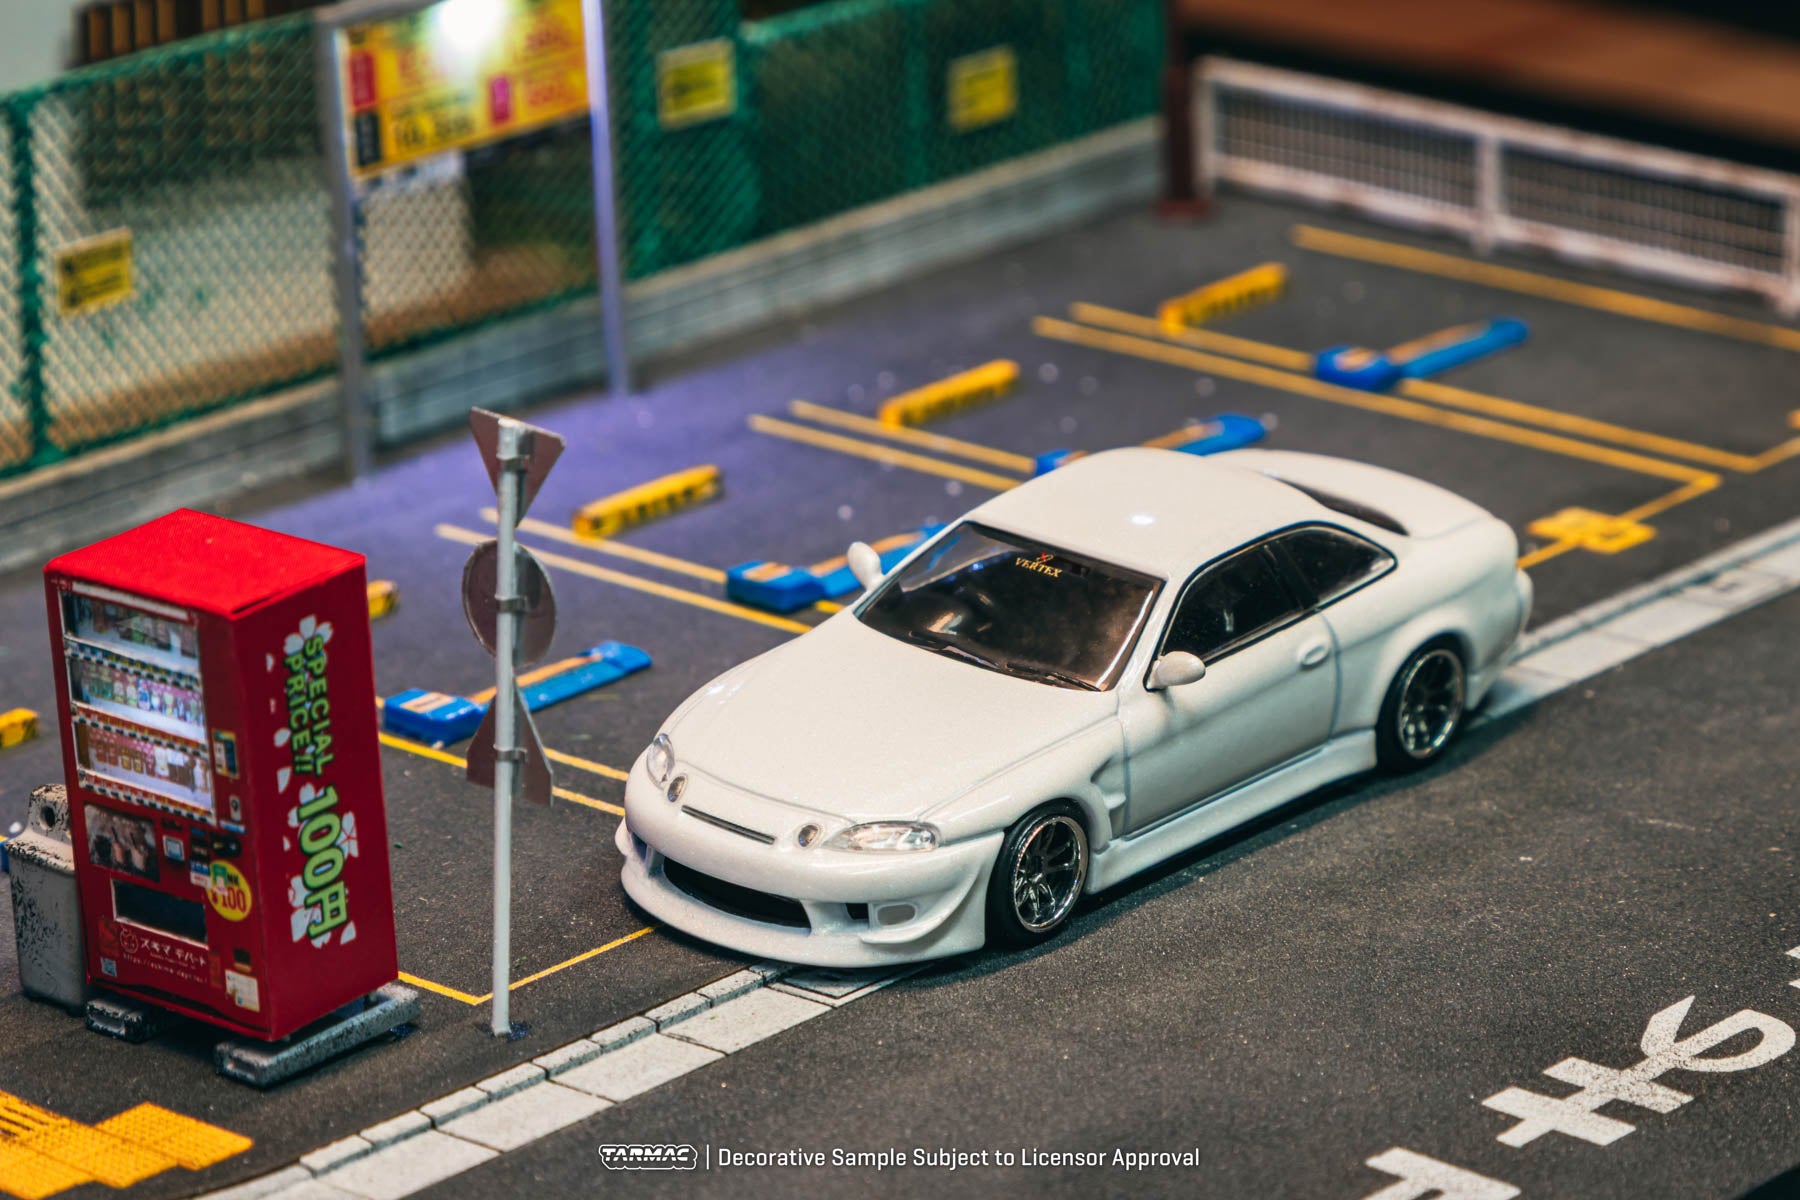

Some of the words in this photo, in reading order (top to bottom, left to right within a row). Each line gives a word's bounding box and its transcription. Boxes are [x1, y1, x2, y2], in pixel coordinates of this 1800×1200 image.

[1015, 557, 1063, 578] VERTEX
[283, 651, 313, 775] PRICE!!
[304, 633, 335, 776] SPECIAL
[297, 783, 348, 940] 100円
